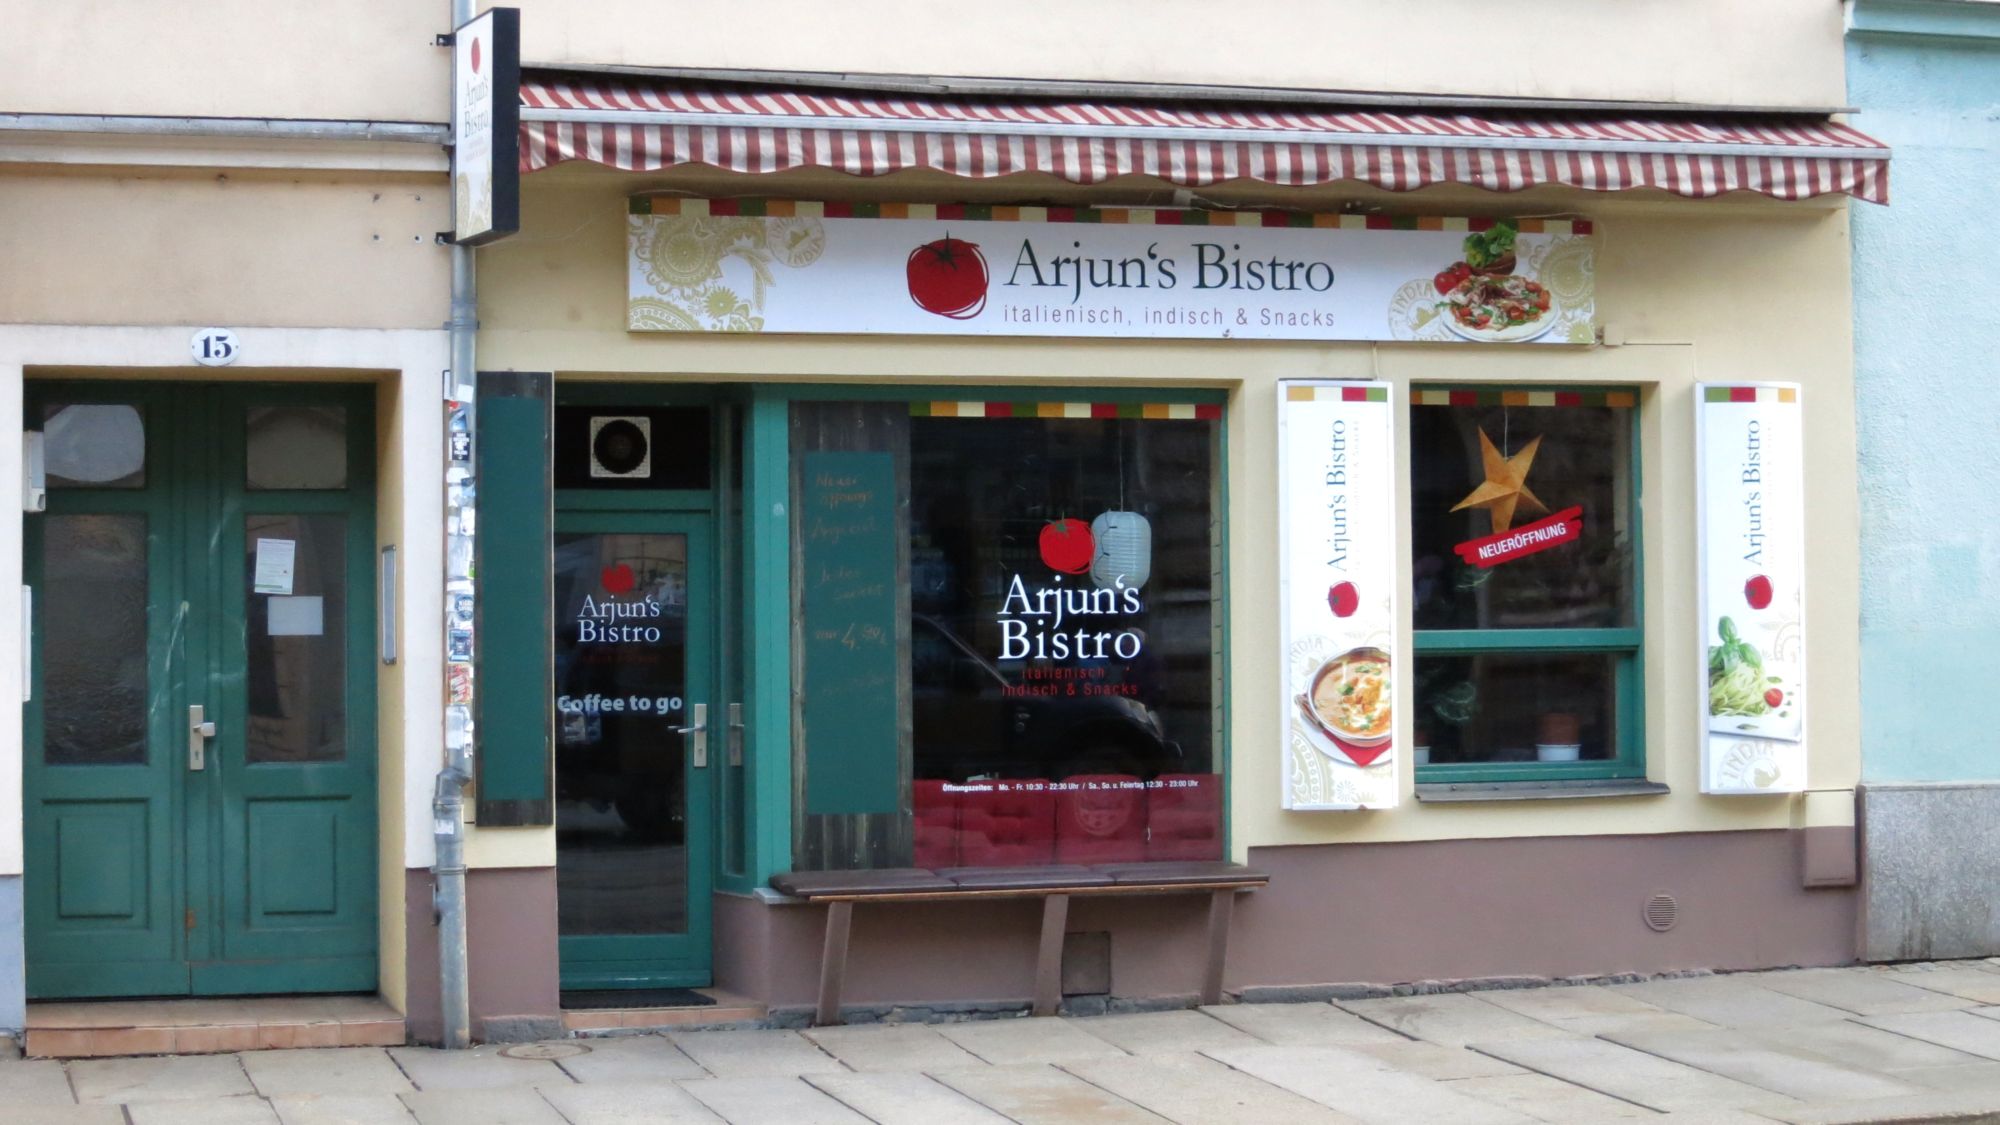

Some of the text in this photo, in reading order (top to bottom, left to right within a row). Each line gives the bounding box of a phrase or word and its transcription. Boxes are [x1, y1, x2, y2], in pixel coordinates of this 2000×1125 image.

[464, 109, 489, 138] Bistro
[1003, 238, 1335, 305] Arjun's Bistro
[1004, 305, 1335, 328] italienisch, indisch & Snacks
[201, 335, 232, 358] 15
[1325, 419, 1347, 486] Bistro
[1742, 419, 1762, 485] Bistro
[1478, 522, 1567, 560] NEUERÖFFNUNG
[577, 594, 660, 625] Arjun's
[997, 573, 1141, 630] Arjun's
[577, 619, 660, 643] Bistro
[997, 618, 1141, 660] Bistro
[1022, 666, 1105, 680] italienisch
[1002, 681, 1138, 697] indisch & Snacks
[557, 694, 683, 715] Coffee to go
[1049, 782, 1067, 790] 22:30
[1068, 782, 1080, 790] Uhr
[1120, 781, 1145, 790] Feiertag
[1187, 779, 1199, 787] Uhr
